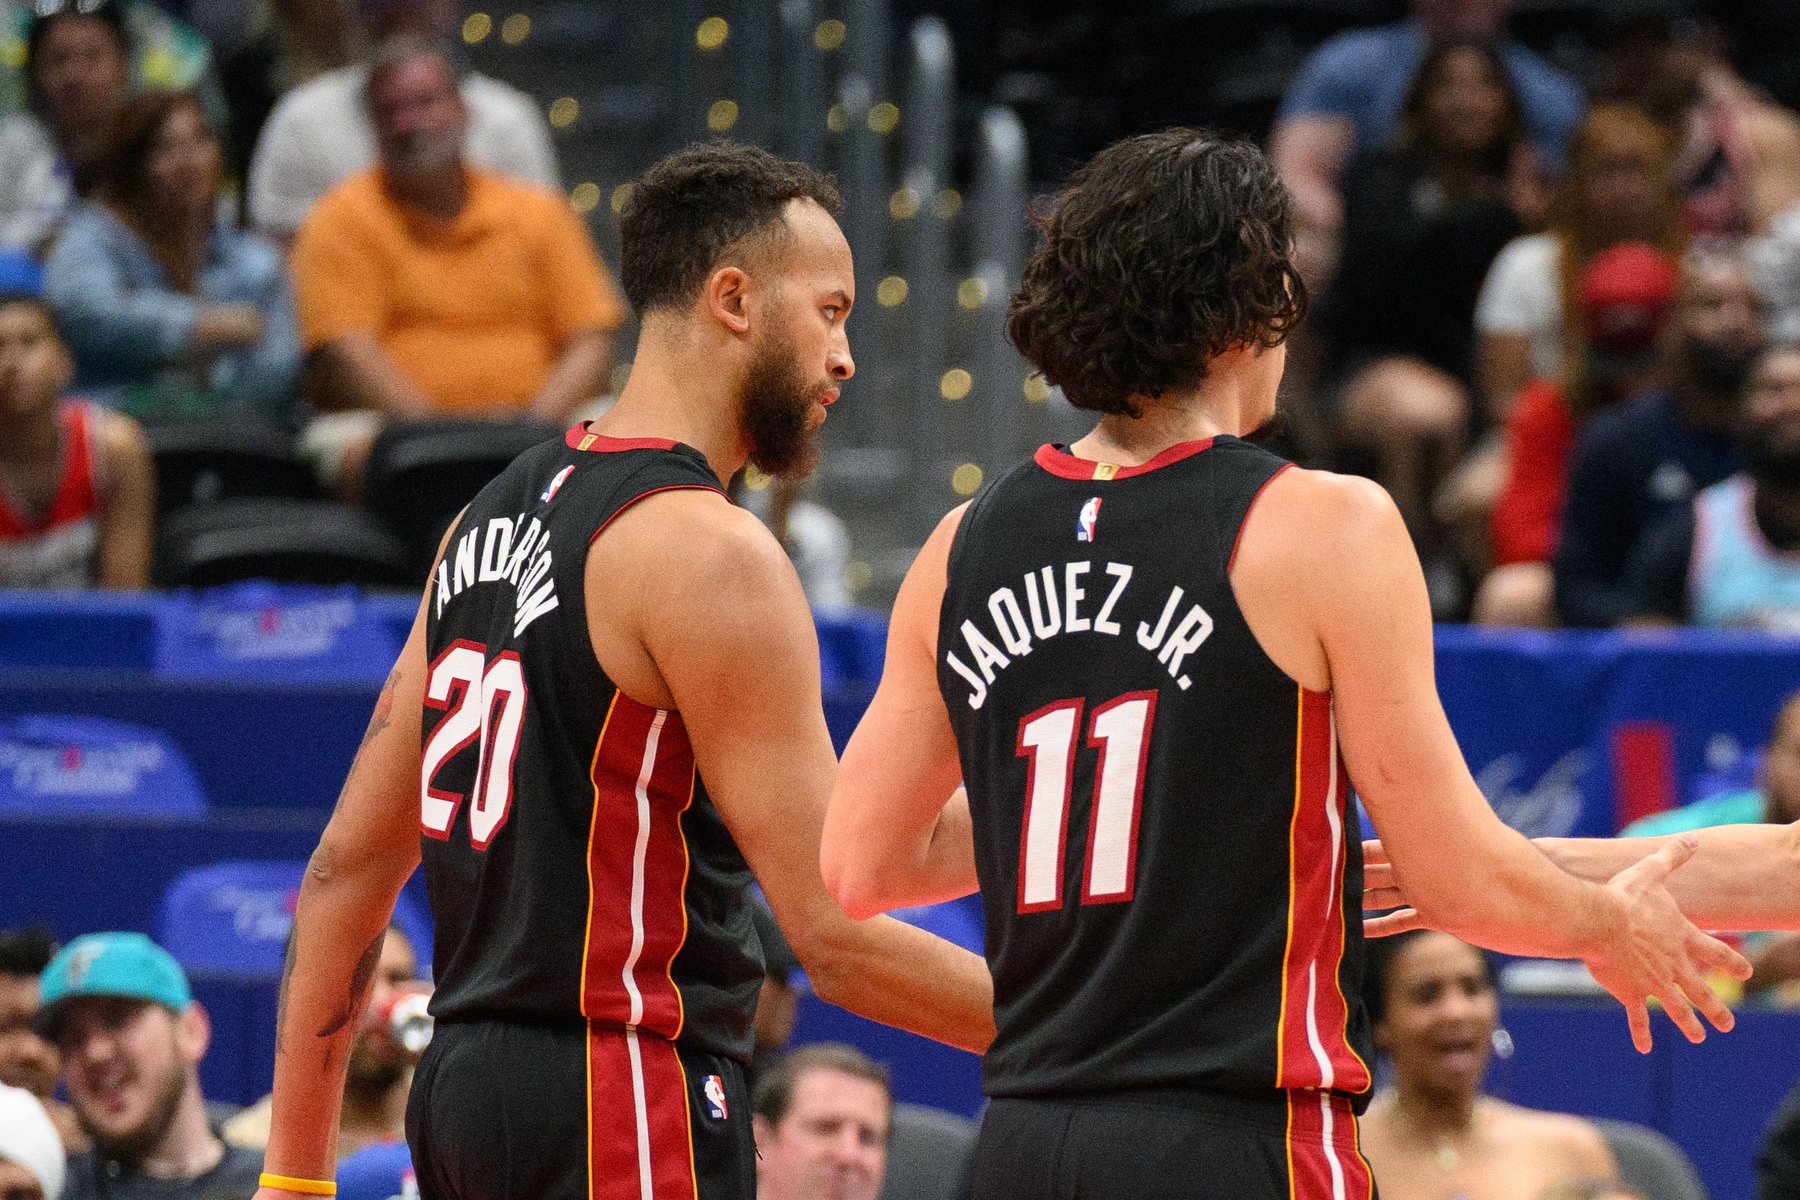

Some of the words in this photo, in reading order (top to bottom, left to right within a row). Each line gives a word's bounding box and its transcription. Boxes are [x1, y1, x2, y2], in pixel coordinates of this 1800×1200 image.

[946, 560, 1134, 710] JAQUEZ
[1136, 586, 1214, 691] JR.
[420, 638, 528, 851] 20
[1015, 689, 1158, 914] 11
